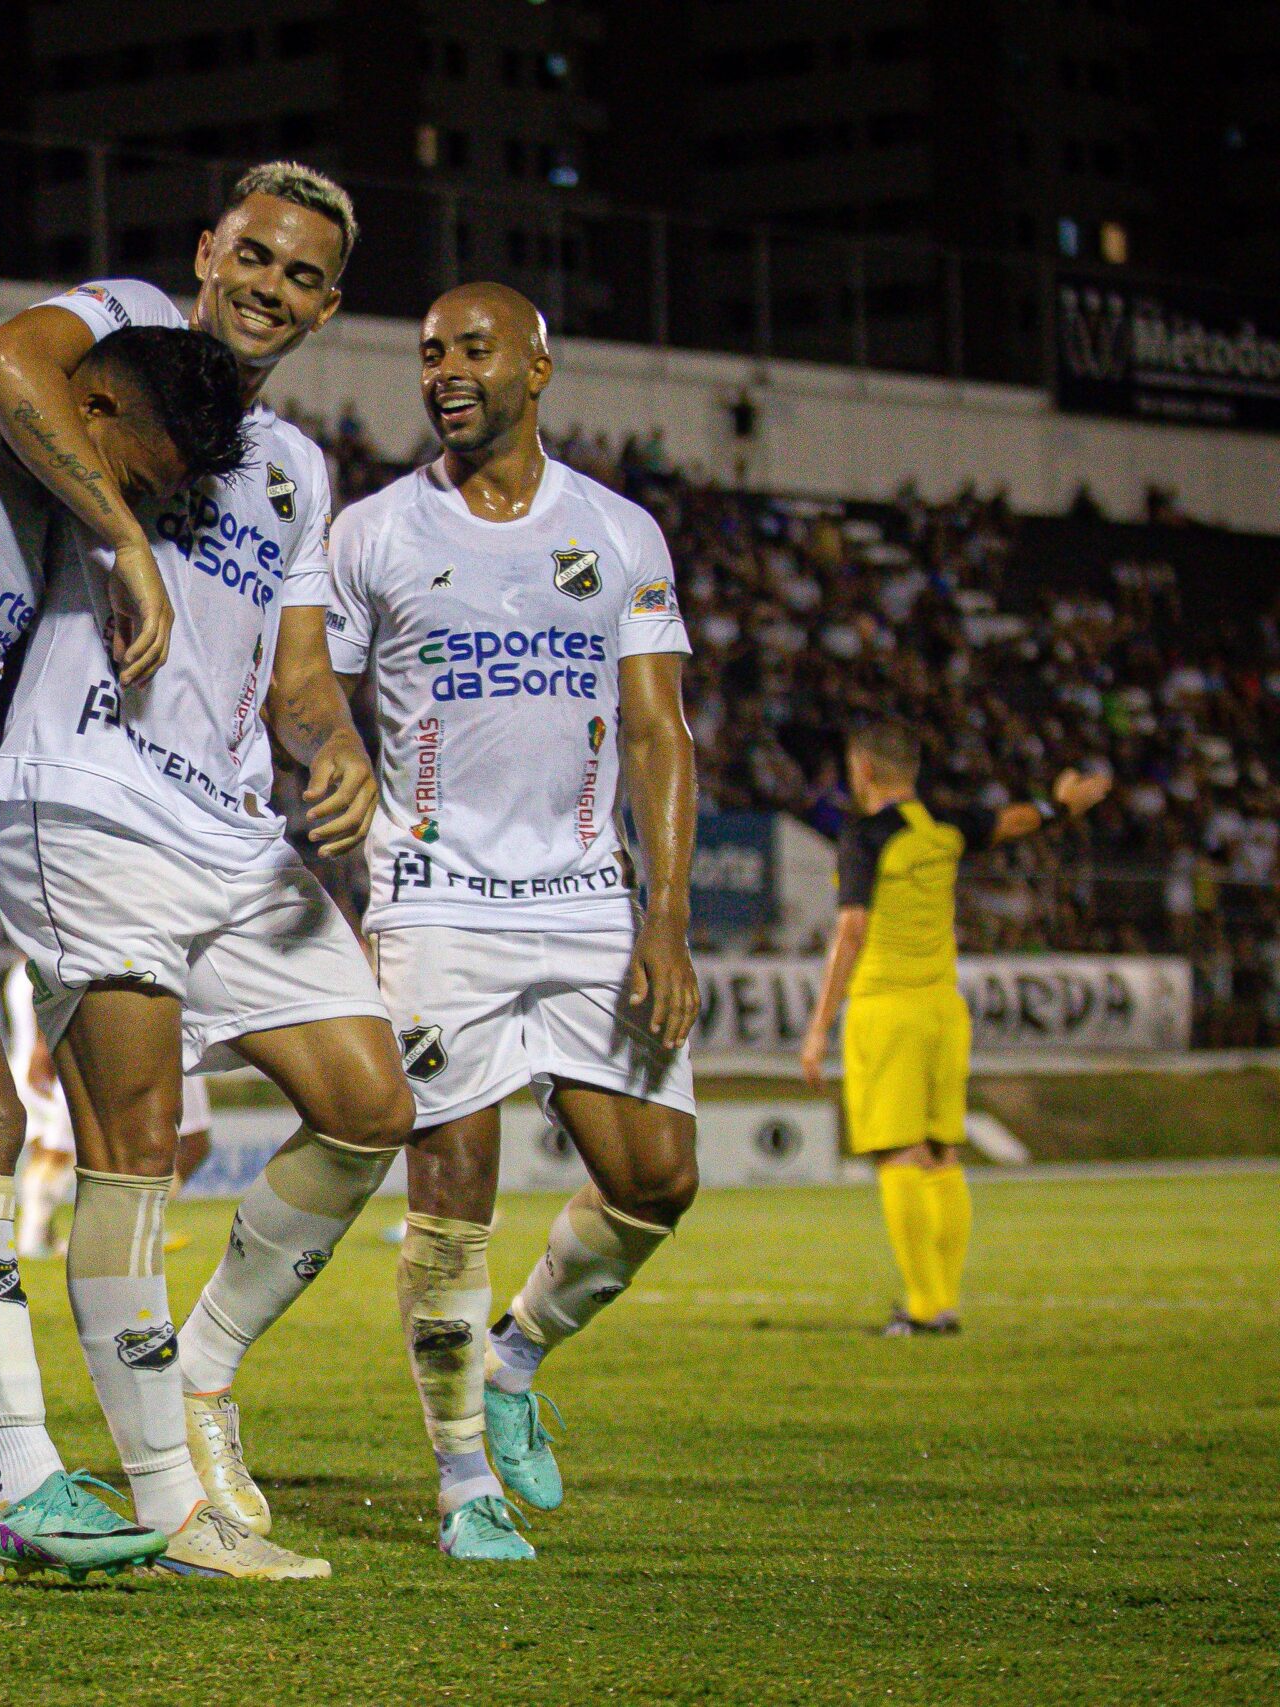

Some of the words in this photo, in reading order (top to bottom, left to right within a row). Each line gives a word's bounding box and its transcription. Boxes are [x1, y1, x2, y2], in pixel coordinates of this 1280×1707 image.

[419, 624, 606, 668] Esportes
[414, 717, 439, 814] FRIGOIÁS
[125, 1342, 156, 1359] ABC
